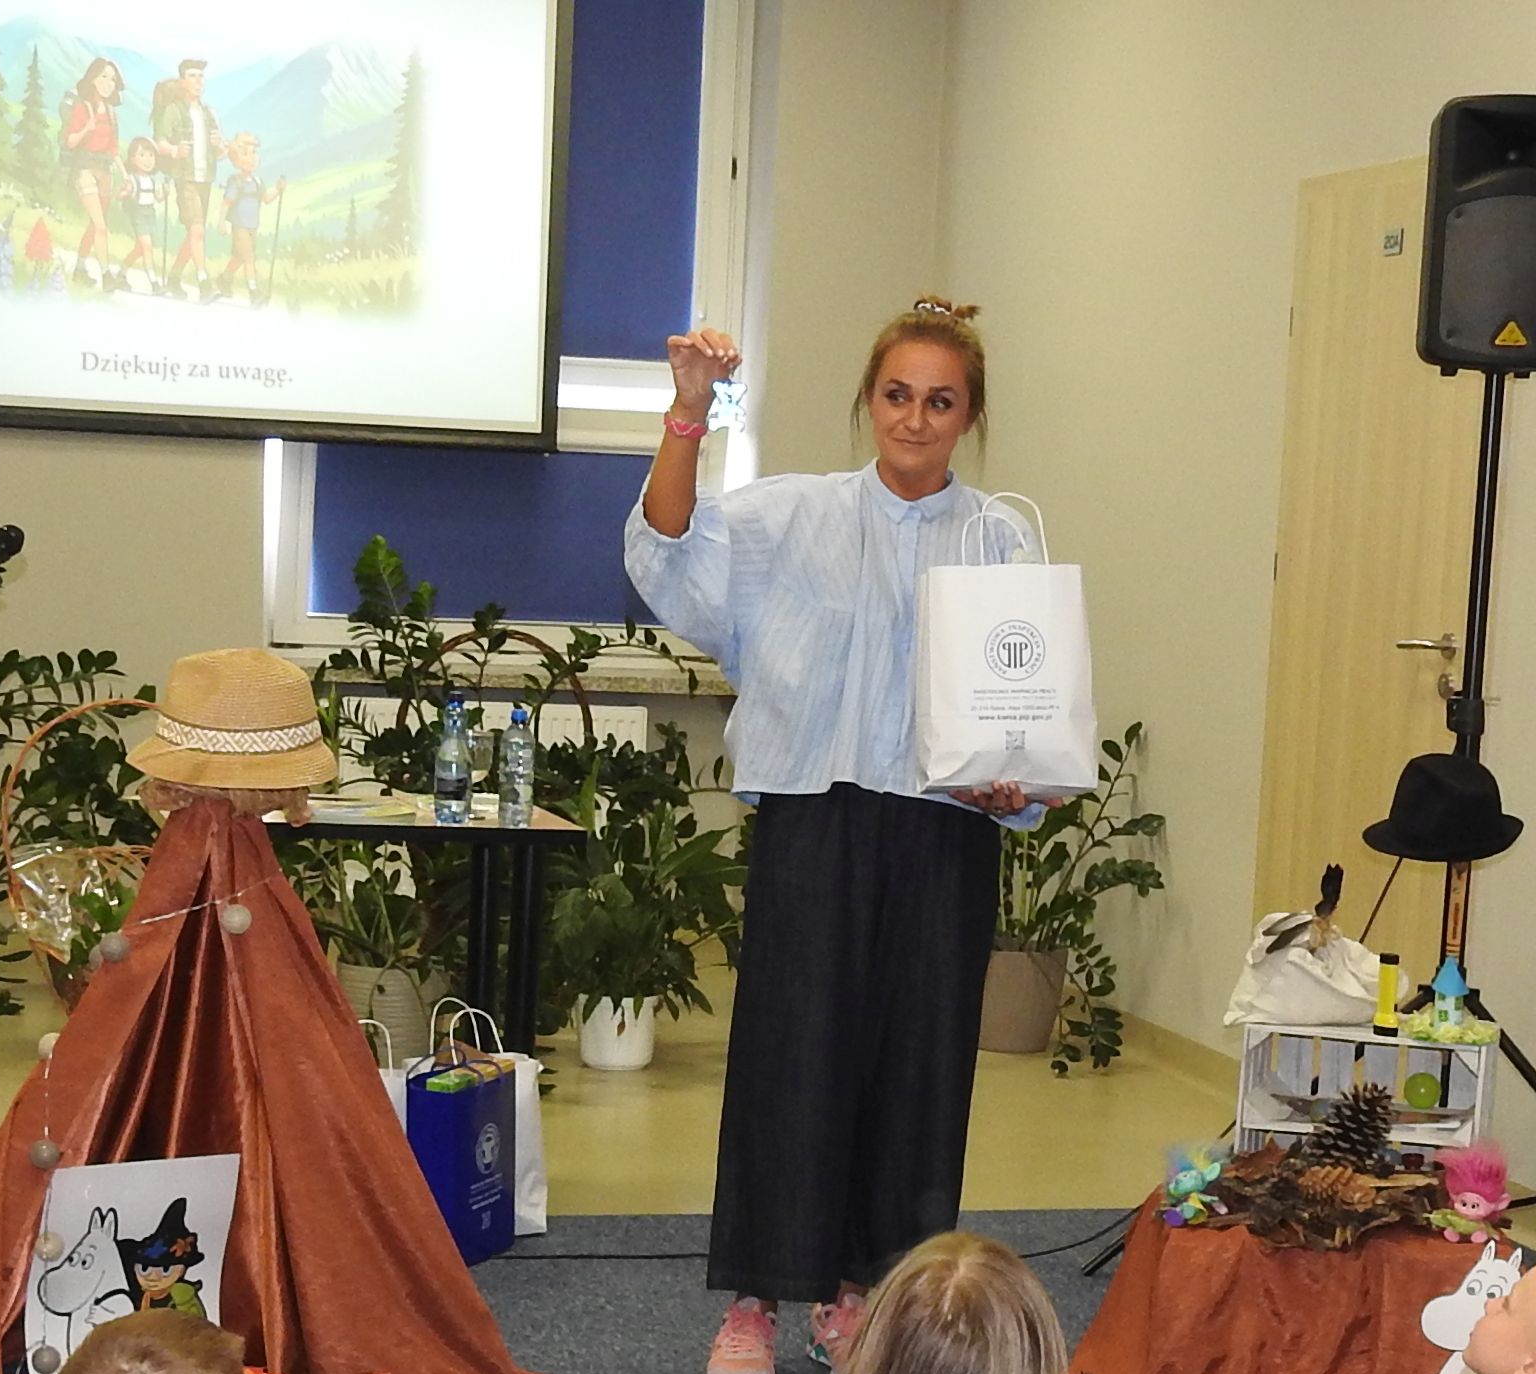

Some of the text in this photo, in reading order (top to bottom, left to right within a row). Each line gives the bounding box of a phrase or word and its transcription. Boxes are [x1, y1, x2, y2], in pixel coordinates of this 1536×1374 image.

[80, 351, 293, 388] Dziękuję za uwagę.
